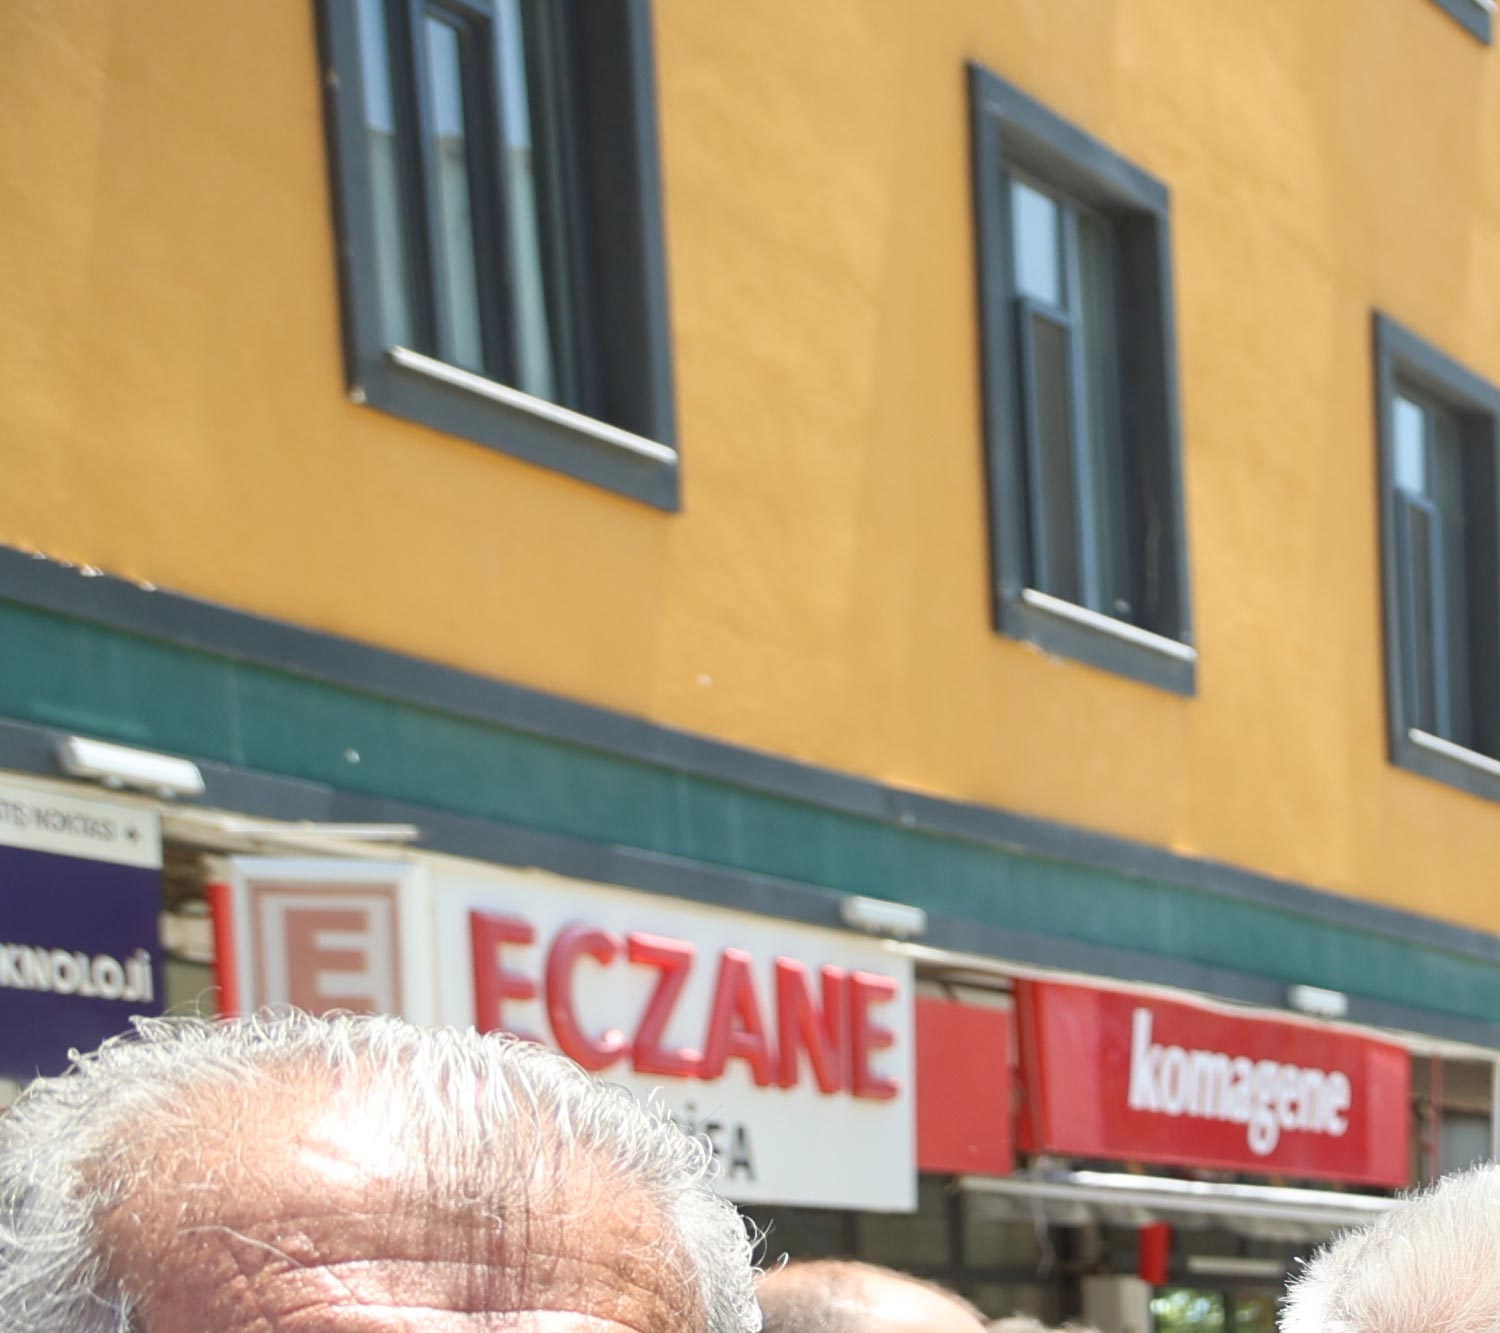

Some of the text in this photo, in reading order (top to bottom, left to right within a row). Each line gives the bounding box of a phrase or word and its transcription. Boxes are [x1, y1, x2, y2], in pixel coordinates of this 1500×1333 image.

[283, 909, 376, 1018] E
[469, 909, 899, 1100] ECZANE
[1128, 1007, 1351, 1156] komagene
